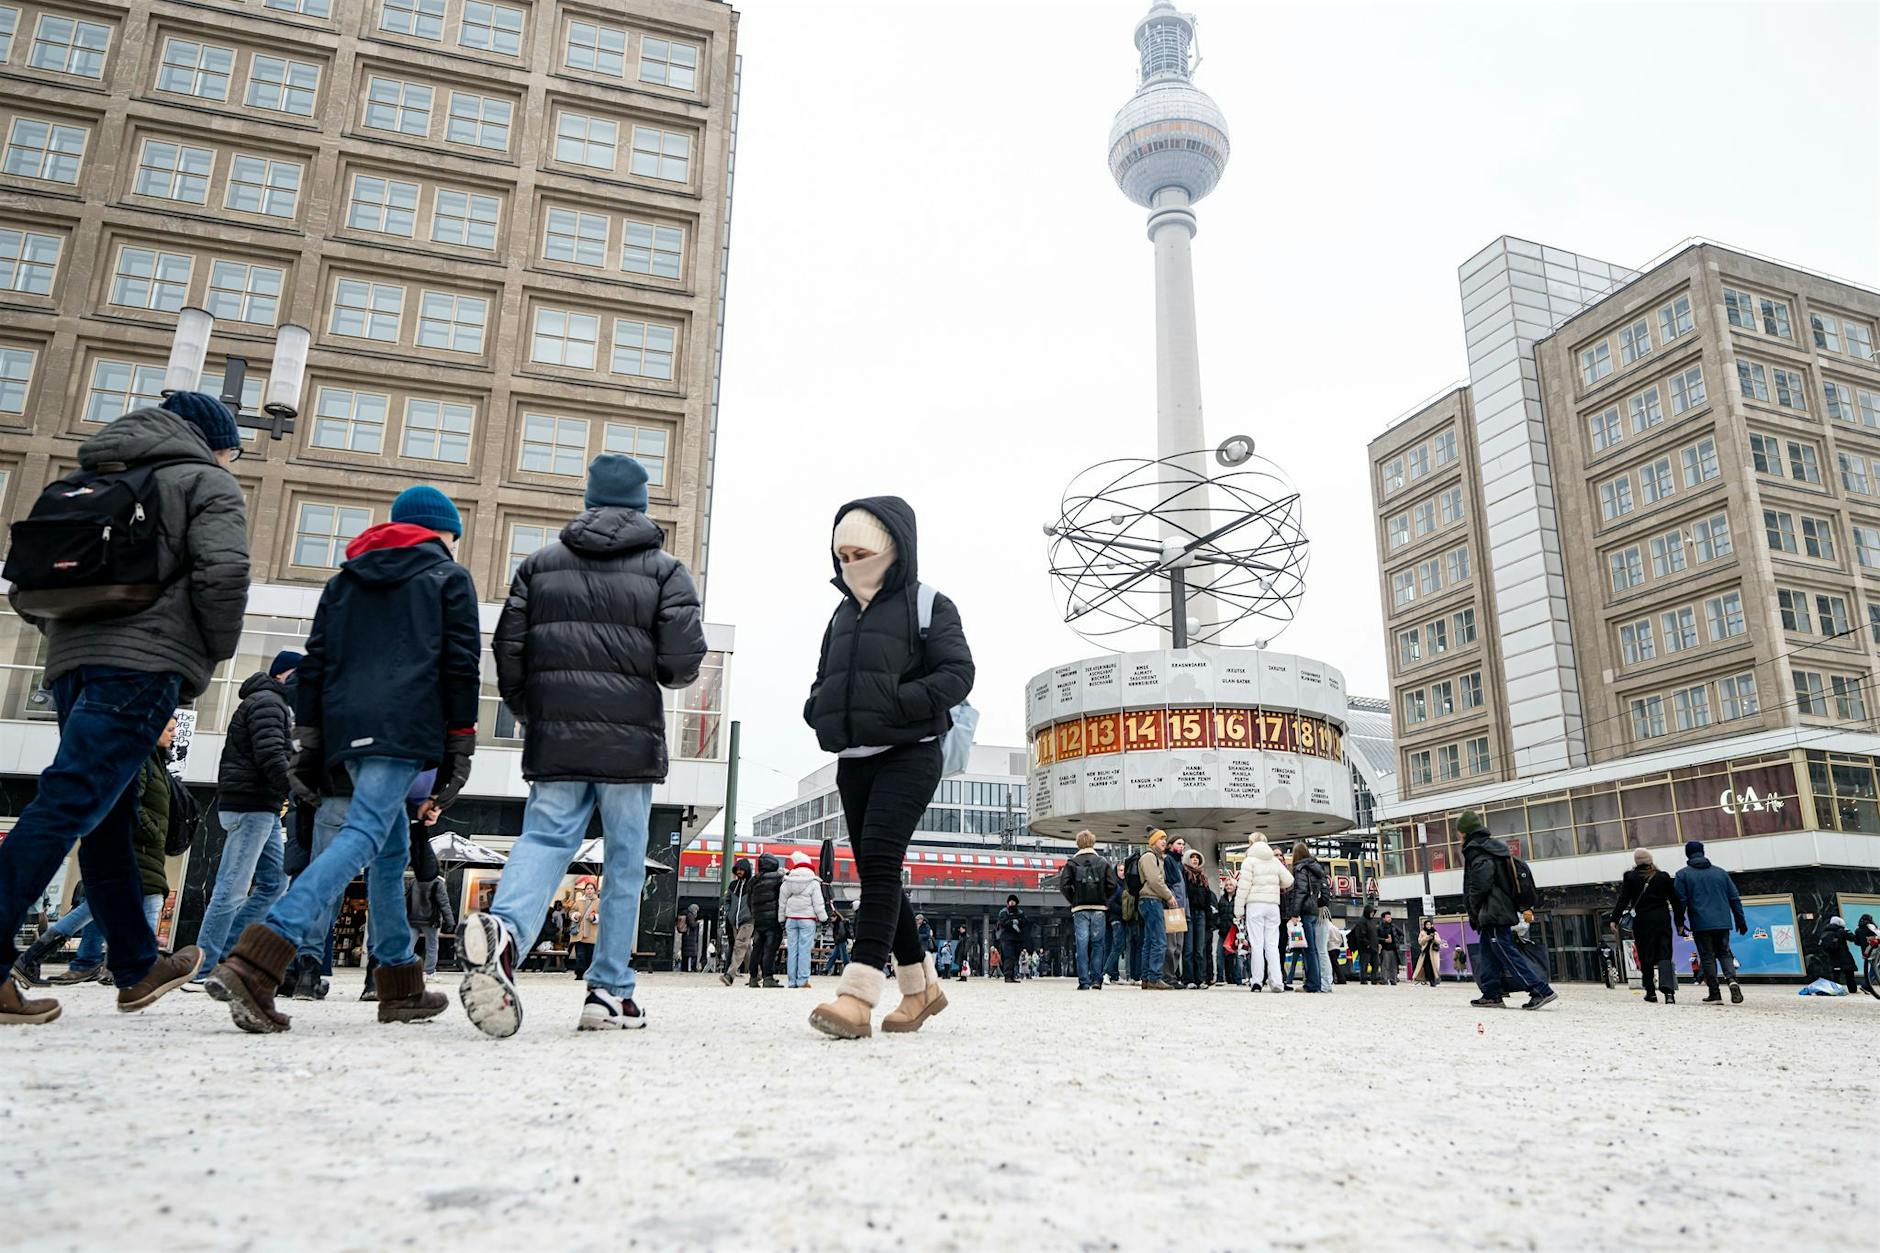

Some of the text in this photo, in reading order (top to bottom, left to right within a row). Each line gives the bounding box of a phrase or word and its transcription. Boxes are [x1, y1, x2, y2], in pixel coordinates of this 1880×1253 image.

[1060, 725, 1081, 752] 12
[1089, 720, 1115, 746] 13
[1125, 715, 1156, 742] 14
[1169, 715, 1201, 740] 15
[1215, 714, 1245, 740] 16
[1255, 717, 1283, 742] 17
[1292, 721, 1314, 747] 18
[1720, 786, 1765, 815] C&A
